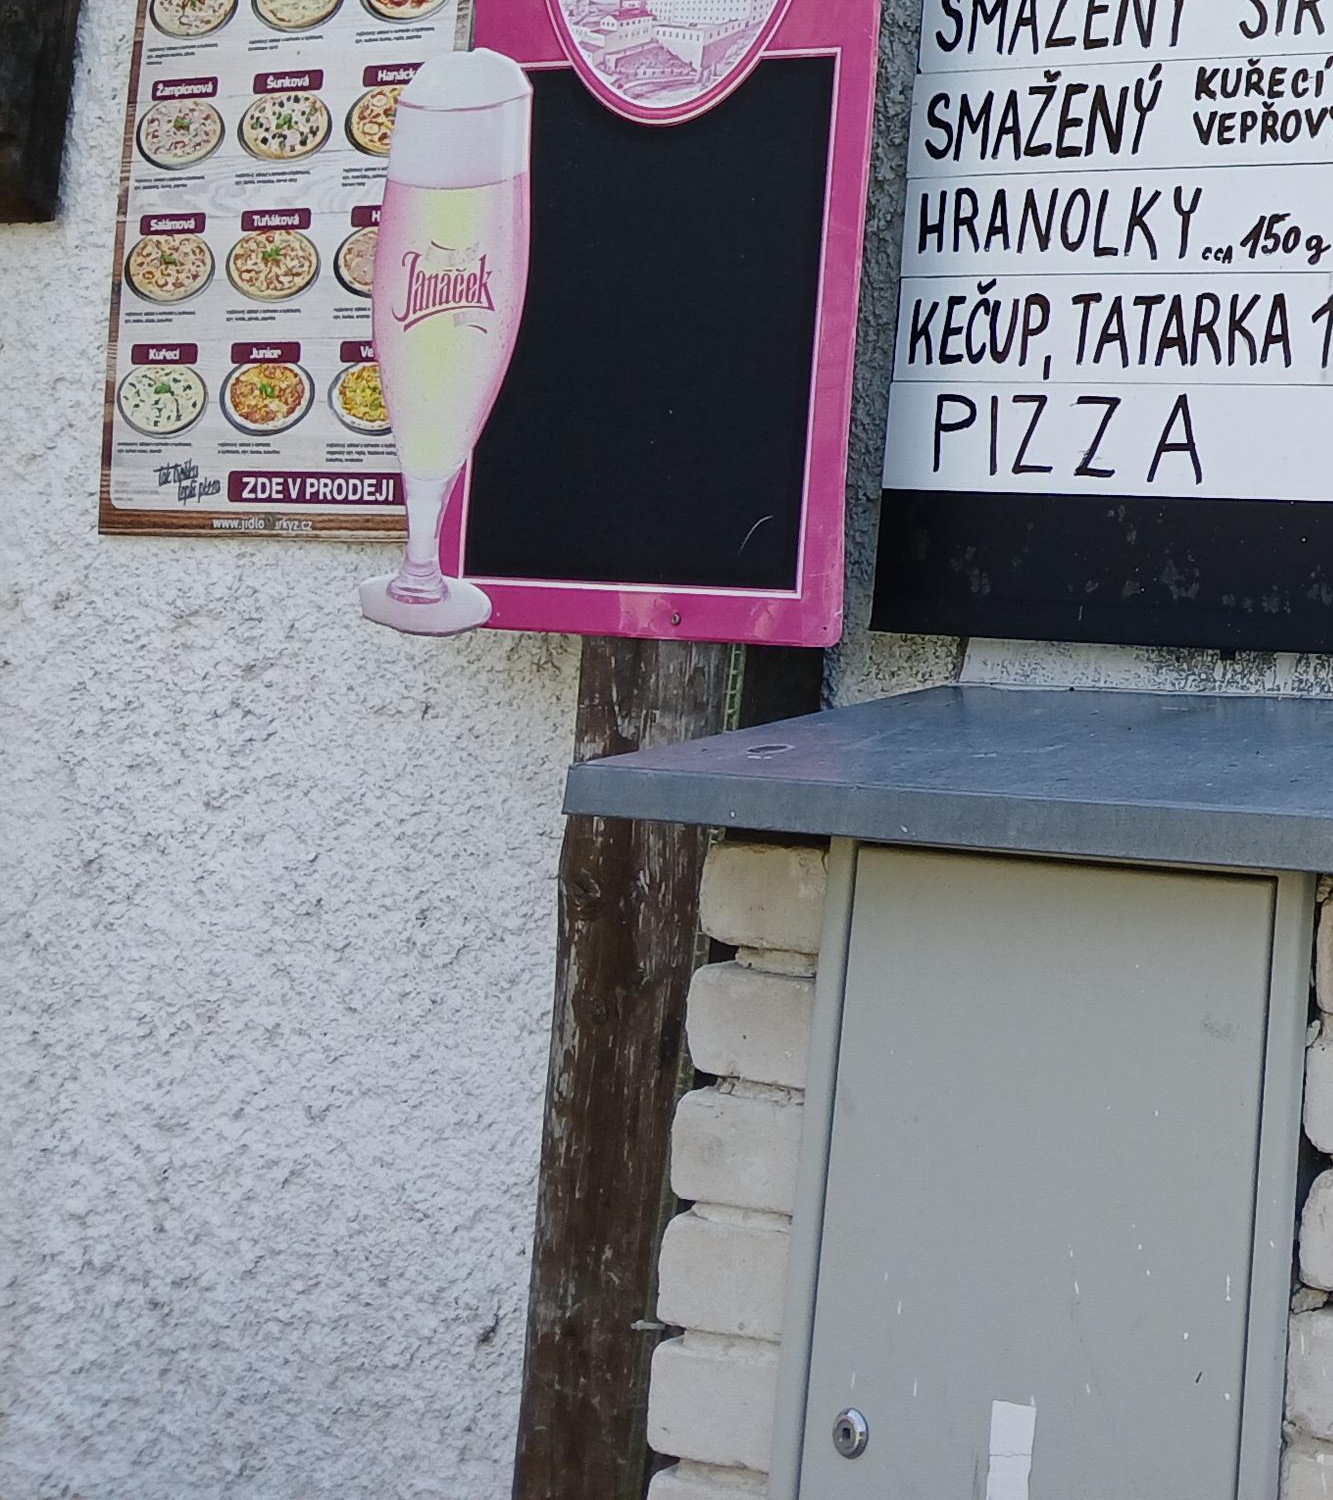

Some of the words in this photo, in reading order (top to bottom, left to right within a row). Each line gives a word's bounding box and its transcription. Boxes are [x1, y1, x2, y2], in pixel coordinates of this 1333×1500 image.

[266, 75, 310, 89] Šunková
[925, 63, 1162, 162] SMAŽENÝ
[916, 182, 1202, 260] HRANOLKY
[249, 347, 282, 359] Junior
[908, 278, 1051, 380] KEČUP,
[1072, 292, 1291, 369] TATARKA
[933, 393, 1202, 485] PIZZA
[241, 477, 285, 499] ZDE
[288, 478, 302, 500] V
[305, 478, 395, 501] PRODEJI
